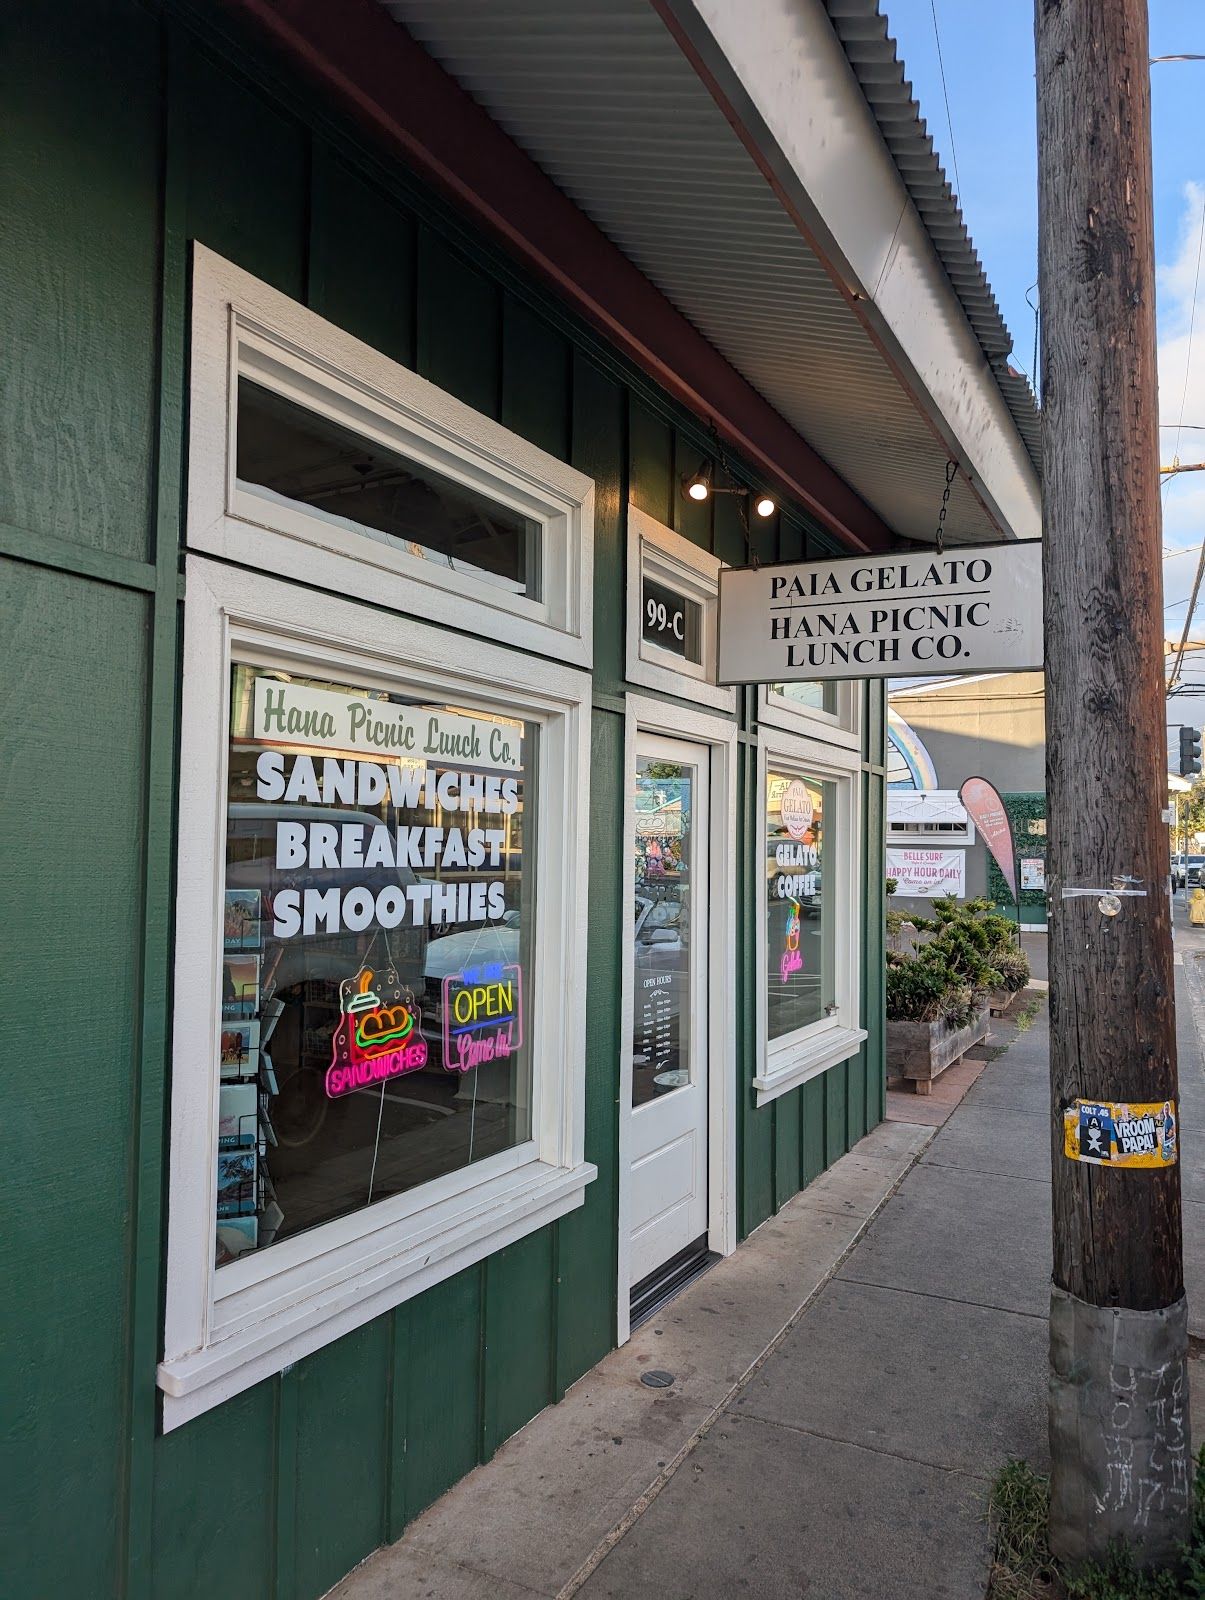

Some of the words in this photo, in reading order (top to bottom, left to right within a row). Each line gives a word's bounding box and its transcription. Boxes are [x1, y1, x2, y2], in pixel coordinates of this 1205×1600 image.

[770, 573, 842, 600] PAIA
[850, 558, 993, 593] GELATO
[646, 597, 685, 642] 99-C
[770, 611, 861, 641] HANA
[869, 602, 991, 634] PICNIC
[785, 638, 900, 668] LUNCH
[911, 633, 971, 661] CO.
[263, 687, 337, 740] Hana
[347, 702, 416, 751] Picnic
[423, 717, 482, 759] Lunch
[489, 727, 517, 767] Co.
[256, 751, 519, 815] SANDWICHES
[783, 798, 811, 815] GELATO
[275, 821, 506, 870] BREAKFAST
[775, 843, 817, 867] GELATO
[903, 851, 923, 861] BELLE
[925, 852, 944, 861] SURF
[777, 874, 817, 899] COFFEE
[886, 867, 913, 878] HAPPY
[913, 867, 938, 878] HOUR
[939, 868, 962, 880] DAILY
[273, 881, 506, 938] SMOOTHIES
[643, 977, 656, 989] OPEN
[656, 974, 672, 986] HOURS
[454, 980, 513, 1024] OPEN
[330, 1042, 426, 1093] SANDWICHES
[456, 1032, 495, 1072] Come
[1081, 1105, 1097, 1116] COLT
[1090, 1117, 1099, 1126] A
[1113, 1117, 1156, 1139] VROOM
[1122, 1135, 1155, 1153] PAPA!
